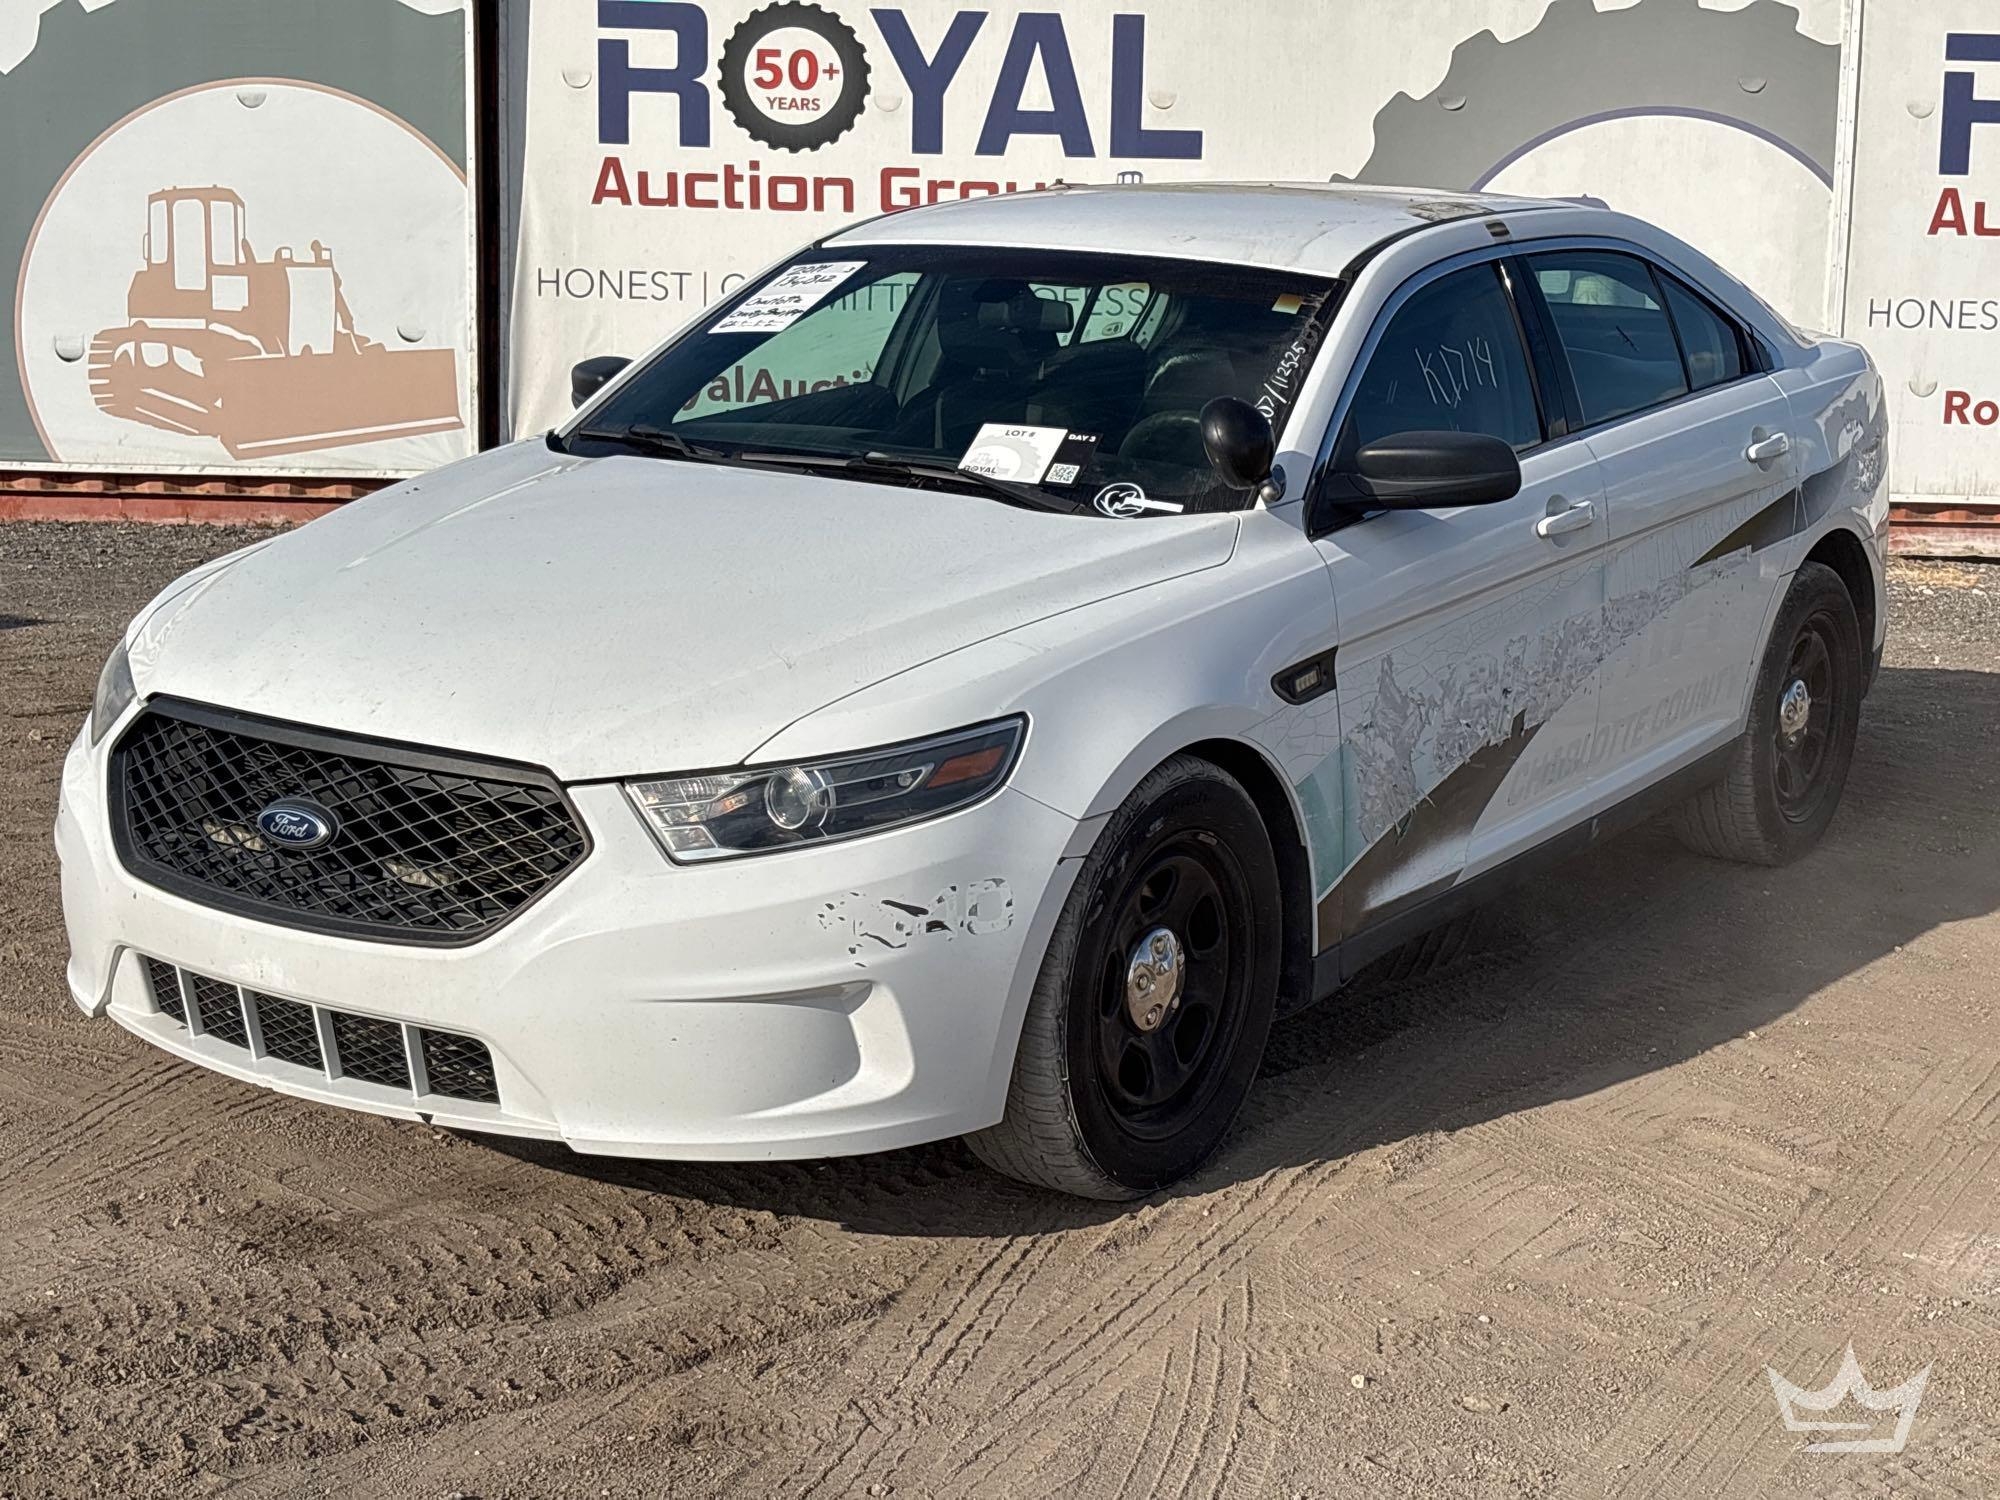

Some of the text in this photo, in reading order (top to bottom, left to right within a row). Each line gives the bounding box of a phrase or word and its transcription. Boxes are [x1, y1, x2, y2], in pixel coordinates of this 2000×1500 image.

[753, 48, 840, 91] 50+
[765, 96, 821, 112] YEARS
[591, 156, 854, 213] Auction
[537, 267, 693, 302] HONEST
[1254, 341, 1306, 426] 07/112525
[1943, 390, 2000, 425] Ro
[1005, 429, 1029, 437] LOT
[1068, 433, 1089, 442] DAY
[270, 813, 309, 838] Ford
